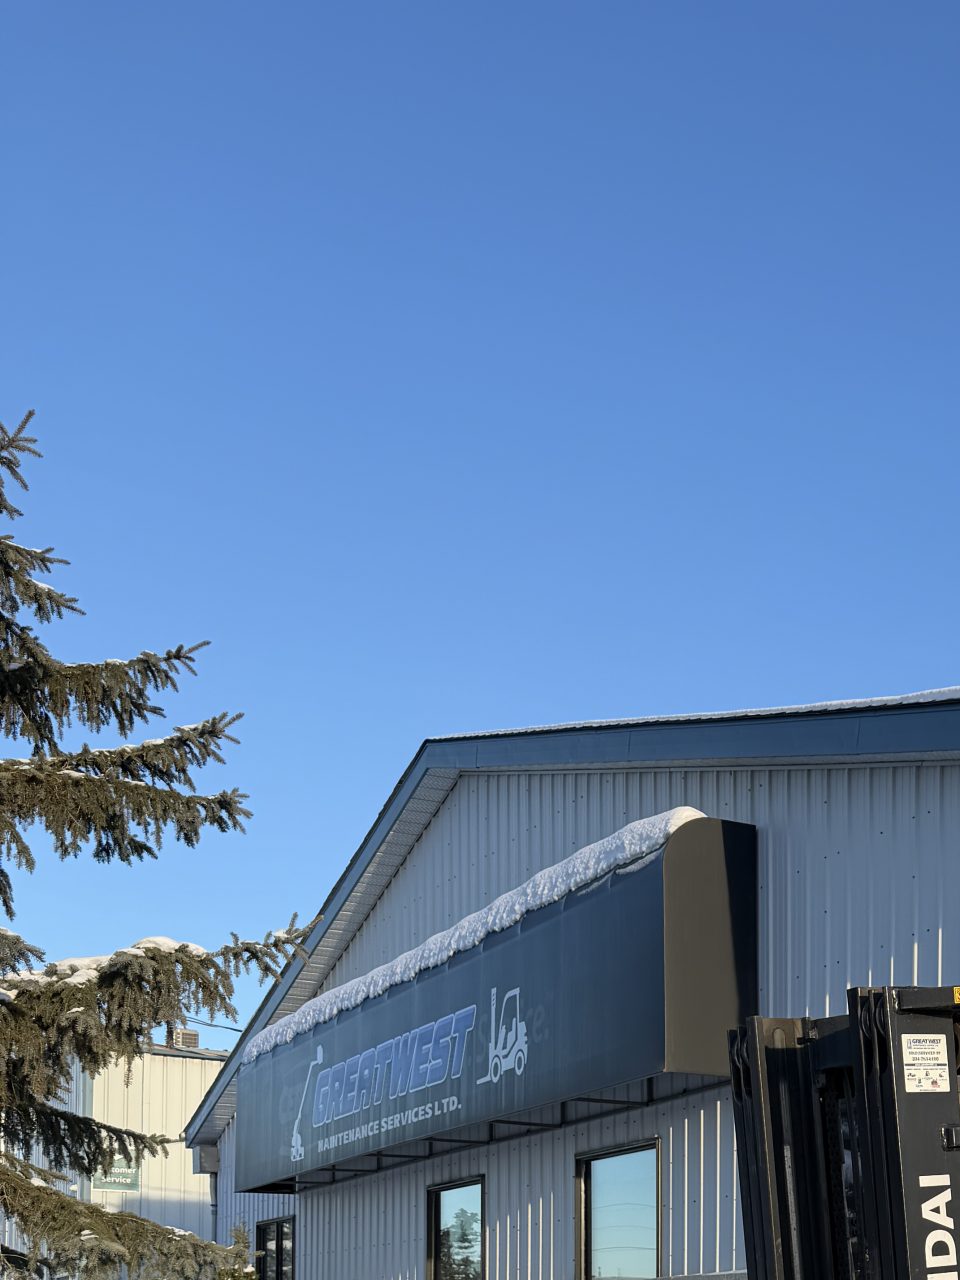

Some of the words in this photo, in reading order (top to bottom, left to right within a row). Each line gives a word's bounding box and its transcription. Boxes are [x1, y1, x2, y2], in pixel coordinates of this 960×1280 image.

[312, 1004, 477, 1128] GREATWEST
[317, 1120, 380, 1153] MAINTENANCE
[381, 1103, 433, 1133] SERVICES
[434, 1095, 462, 1116] LTD.
[97, 1165, 136, 1174] Ctomer
[101, 1176, 131, 1184] Service
